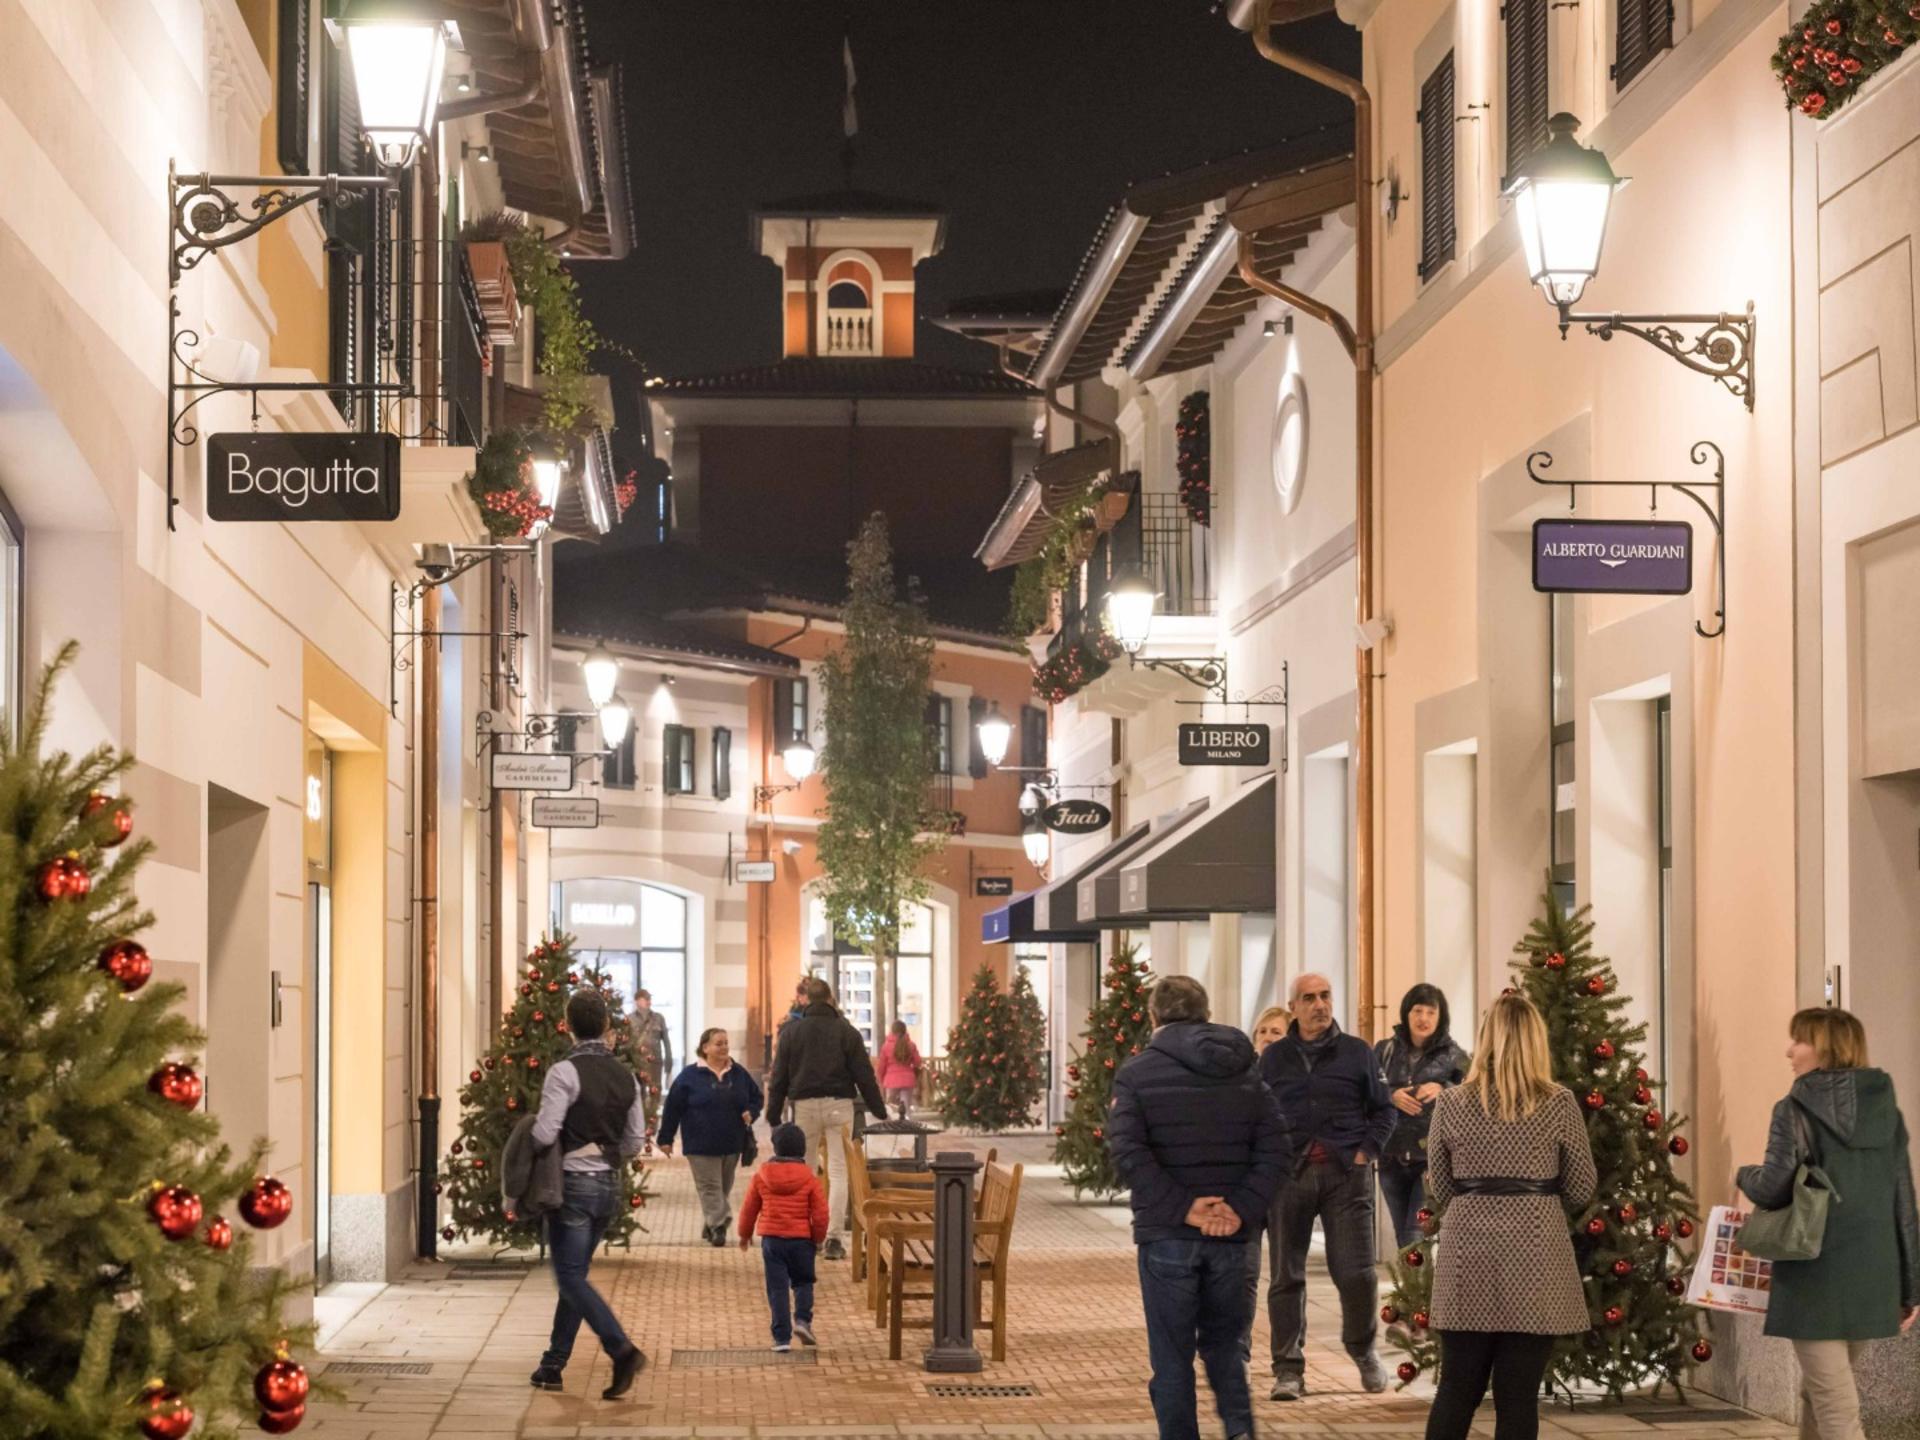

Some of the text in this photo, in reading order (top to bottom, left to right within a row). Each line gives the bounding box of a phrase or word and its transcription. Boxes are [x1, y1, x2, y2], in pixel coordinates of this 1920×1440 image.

[228, 452, 379, 508] Bagutta
[1543, 543, 1685, 560] ALBERTO GUARDIANI
[1188, 730, 1260, 748] LIBERO
[1207, 750, 1242, 758] MILANO
